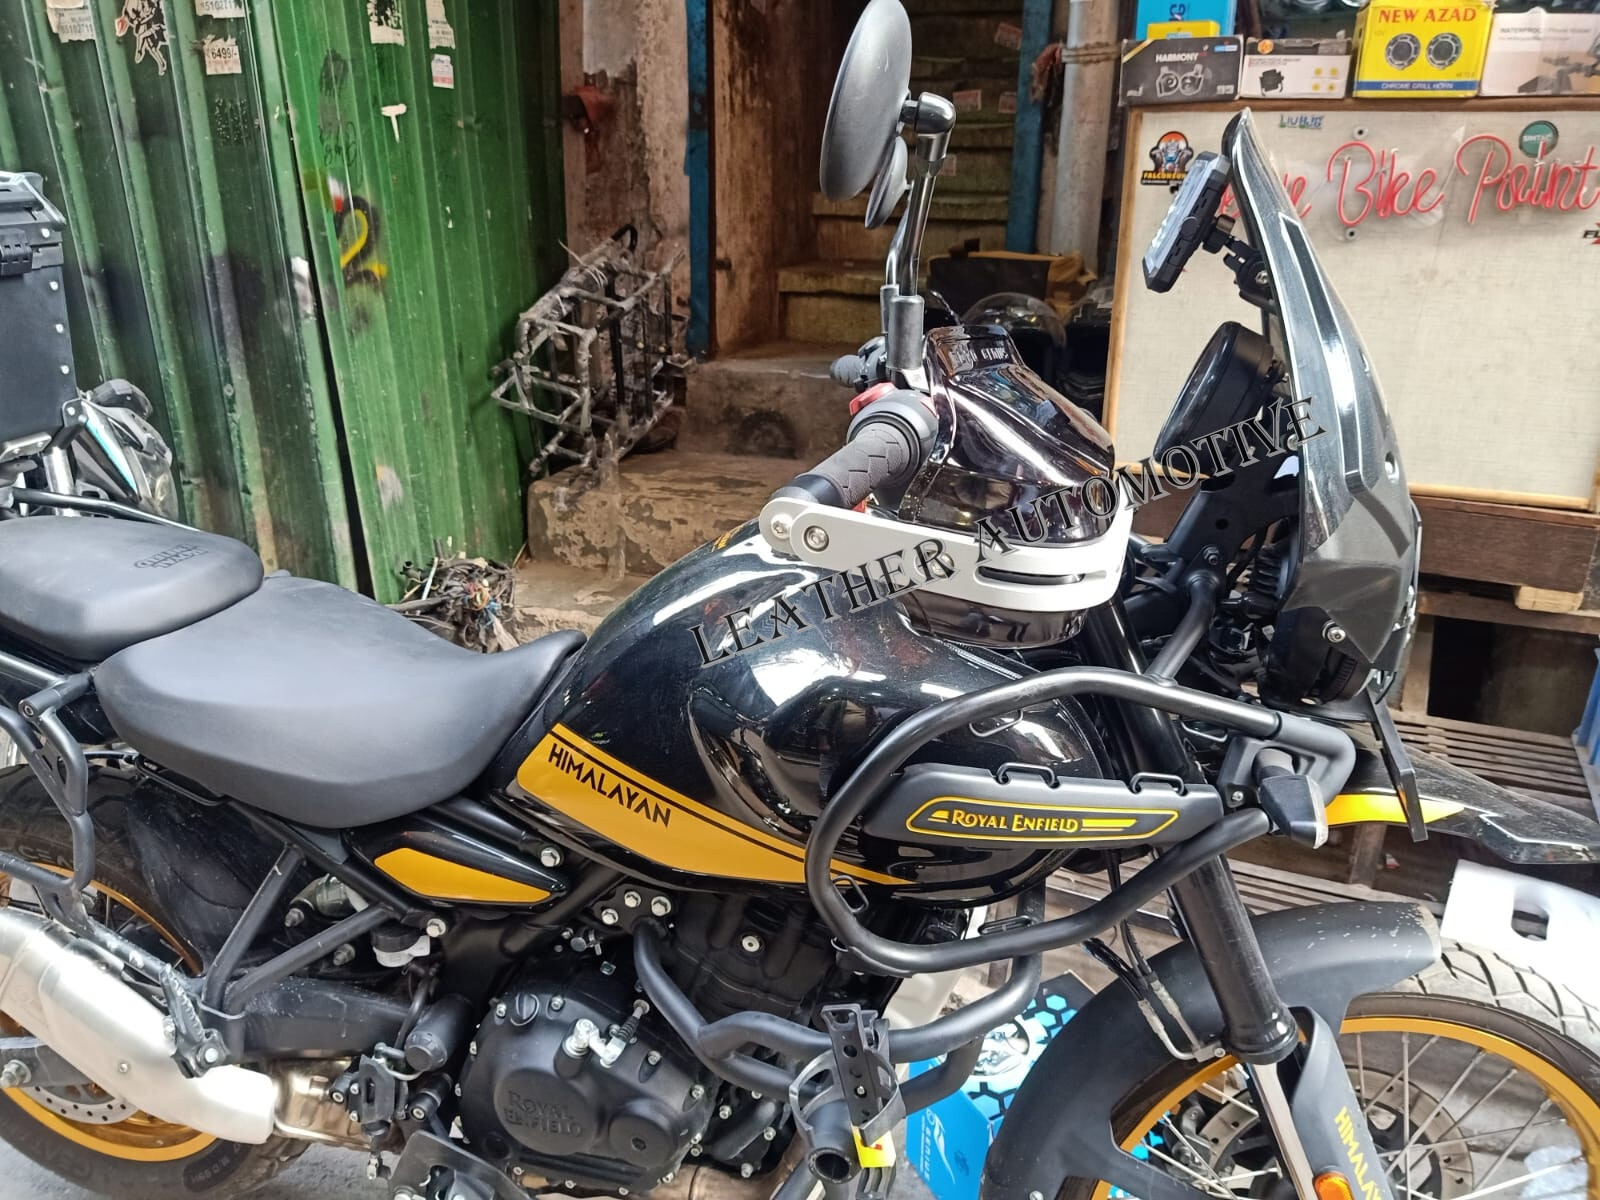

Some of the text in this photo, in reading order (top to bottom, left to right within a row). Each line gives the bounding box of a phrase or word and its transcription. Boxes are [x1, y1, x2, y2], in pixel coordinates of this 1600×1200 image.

[1378, 7, 1477, 23] NEW AZAD
[1155, 52, 1199, 63] HARMONY
[1381, 81, 1453, 90] CHROME GRILL HORN
[1328, 140, 1445, 228] Bike
[547, 742, 672, 828] HIMALAYAN
[952, 808, 1080, 834] ROYAL ENFIELD
[507, 1088, 574, 1120] ROYAL
[503, 1107, 582, 1137] ENFIELD
